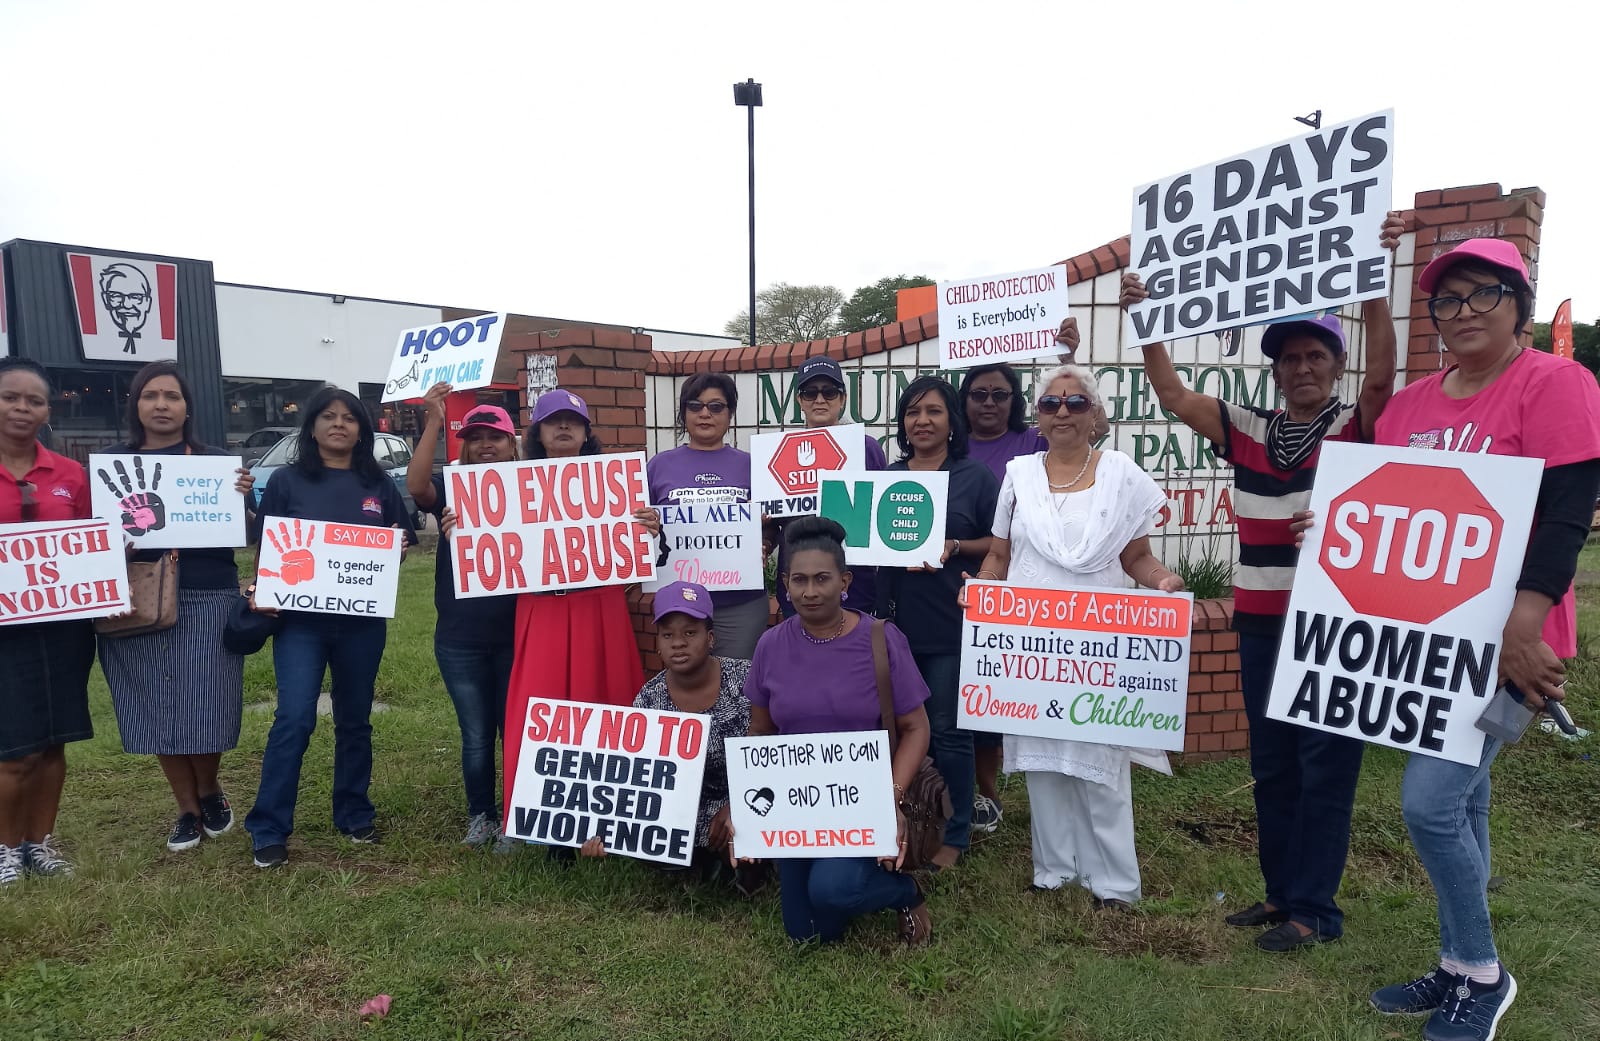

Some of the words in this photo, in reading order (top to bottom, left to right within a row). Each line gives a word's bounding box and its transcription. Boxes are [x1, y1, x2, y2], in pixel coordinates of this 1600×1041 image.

[1138, 173, 1194, 231] 16
[1213, 115, 1388, 212] DAYS
[1138, 177, 1378, 269] AGAINST
[1147, 225, 1354, 300] GENDER
[946, 284, 980, 305] CHILD
[982, 272, 1055, 300] PROTECTION
[1130, 256, 1386, 339] VIOLENCE
[957, 315, 967, 329] is
[972, 303, 1046, 326] Everybody's
[400, 315, 498, 357] HOOT
[948, 328, 1059, 359] RESPONSIBILITY
[421, 368, 433, 390] IF
[434, 363, 456, 384] YOU
[457, 359, 484, 383] CARE
[176, 477, 224, 491] every
[788, 468, 817, 486] STO
[183, 492, 219, 505] child
[452, 468, 506, 529] NO
[517, 458, 645, 524] EXCUSE
[889, 493, 925, 502] EXCUSE
[170, 510, 232, 522] matters
[654, 505, 698, 525] EAL
[705, 504, 751, 522] MEN
[892, 519, 918, 528] CHILD
[897, 506, 915, 515] FOR
[333, 528, 360, 543] SAY
[365, 531, 388, 545] NO
[675, 534, 743, 550] PROTECT
[889, 533, 919, 541] ABUSE
[1328, 500, 1494, 585] STOP
[328, 559, 340, 569] to
[344, 560, 385, 573] gender
[456, 532, 527, 593] FOR
[542, 522, 652, 586] ABUSE
[673, 558, 742, 585] Women
[24, 561, 60, 586] IS
[337, 573, 373, 585] based
[0, 579, 120, 616] NOUGH
[274, 592, 377, 613] VIOLENCE
[977, 586, 995, 615] 16
[998, 588, 1050, 626] Days
[1055, 593, 1078, 621] of
[1083, 593, 1177, 629] Activism
[971, 625, 1014, 650] Lets
[1021, 631, 1074, 654] unite
[1080, 636, 1118, 658] and
[1125, 636, 1183, 663] END
[1293, 610, 1496, 698] WOMEN
[1118, 671, 1178, 693] against
[961, 684, 1039, 720] Women
[1046, 699, 1064, 720] &
[1069, 692, 1183, 732] Children
[1287, 669, 1453, 752] ABUSE
[527, 702, 593, 746] SAY
[597, 709, 647, 753] NO
[658, 715, 703, 760] TO
[534, 747, 677, 790] GENDER
[541, 779, 662, 821] BASED
[515, 806, 690, 860] VIOLENCE
[760, 829, 875, 848] VIOLENCE
